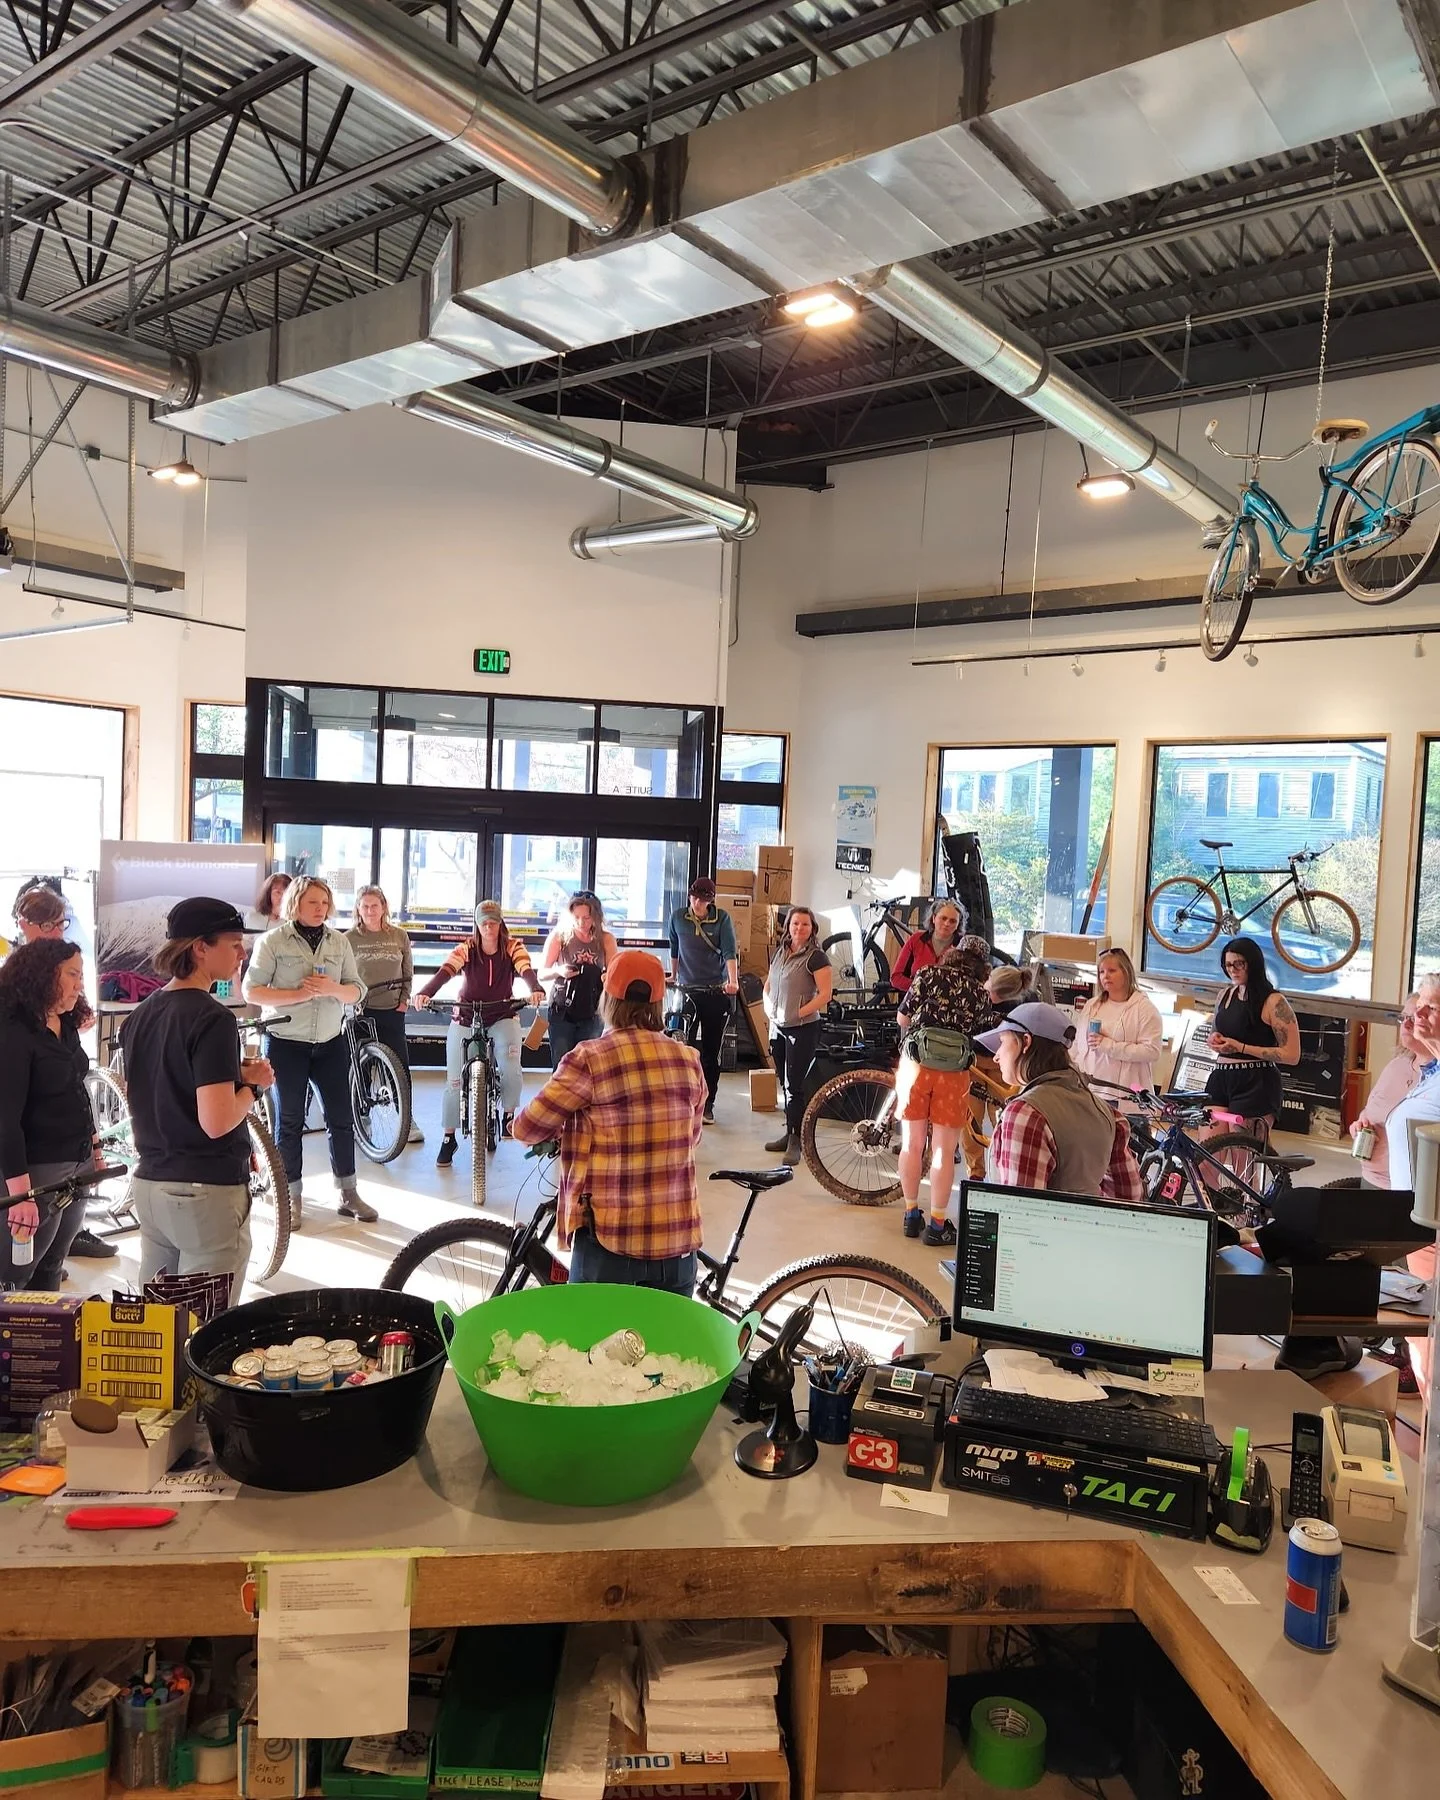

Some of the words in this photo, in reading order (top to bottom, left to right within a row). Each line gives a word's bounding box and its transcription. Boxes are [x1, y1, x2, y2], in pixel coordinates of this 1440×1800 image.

[478, 649, 506, 672] EXIT
[130, 855, 172, 869] Black
[175, 857, 240, 870] Diamond
[836, 861, 870, 873] TECNICA
[1282, 1100, 1305, 1110] THU
[853, 1440, 894, 1470] G3
[965, 1443, 1018, 1462] mrp
[255, 1763, 280, 1773] GIFT
[469, 1776, 505, 1787] LEASE
[515, 1779, 541, 1788] DOWN
[604, 1783, 732, 1799] ANGER
